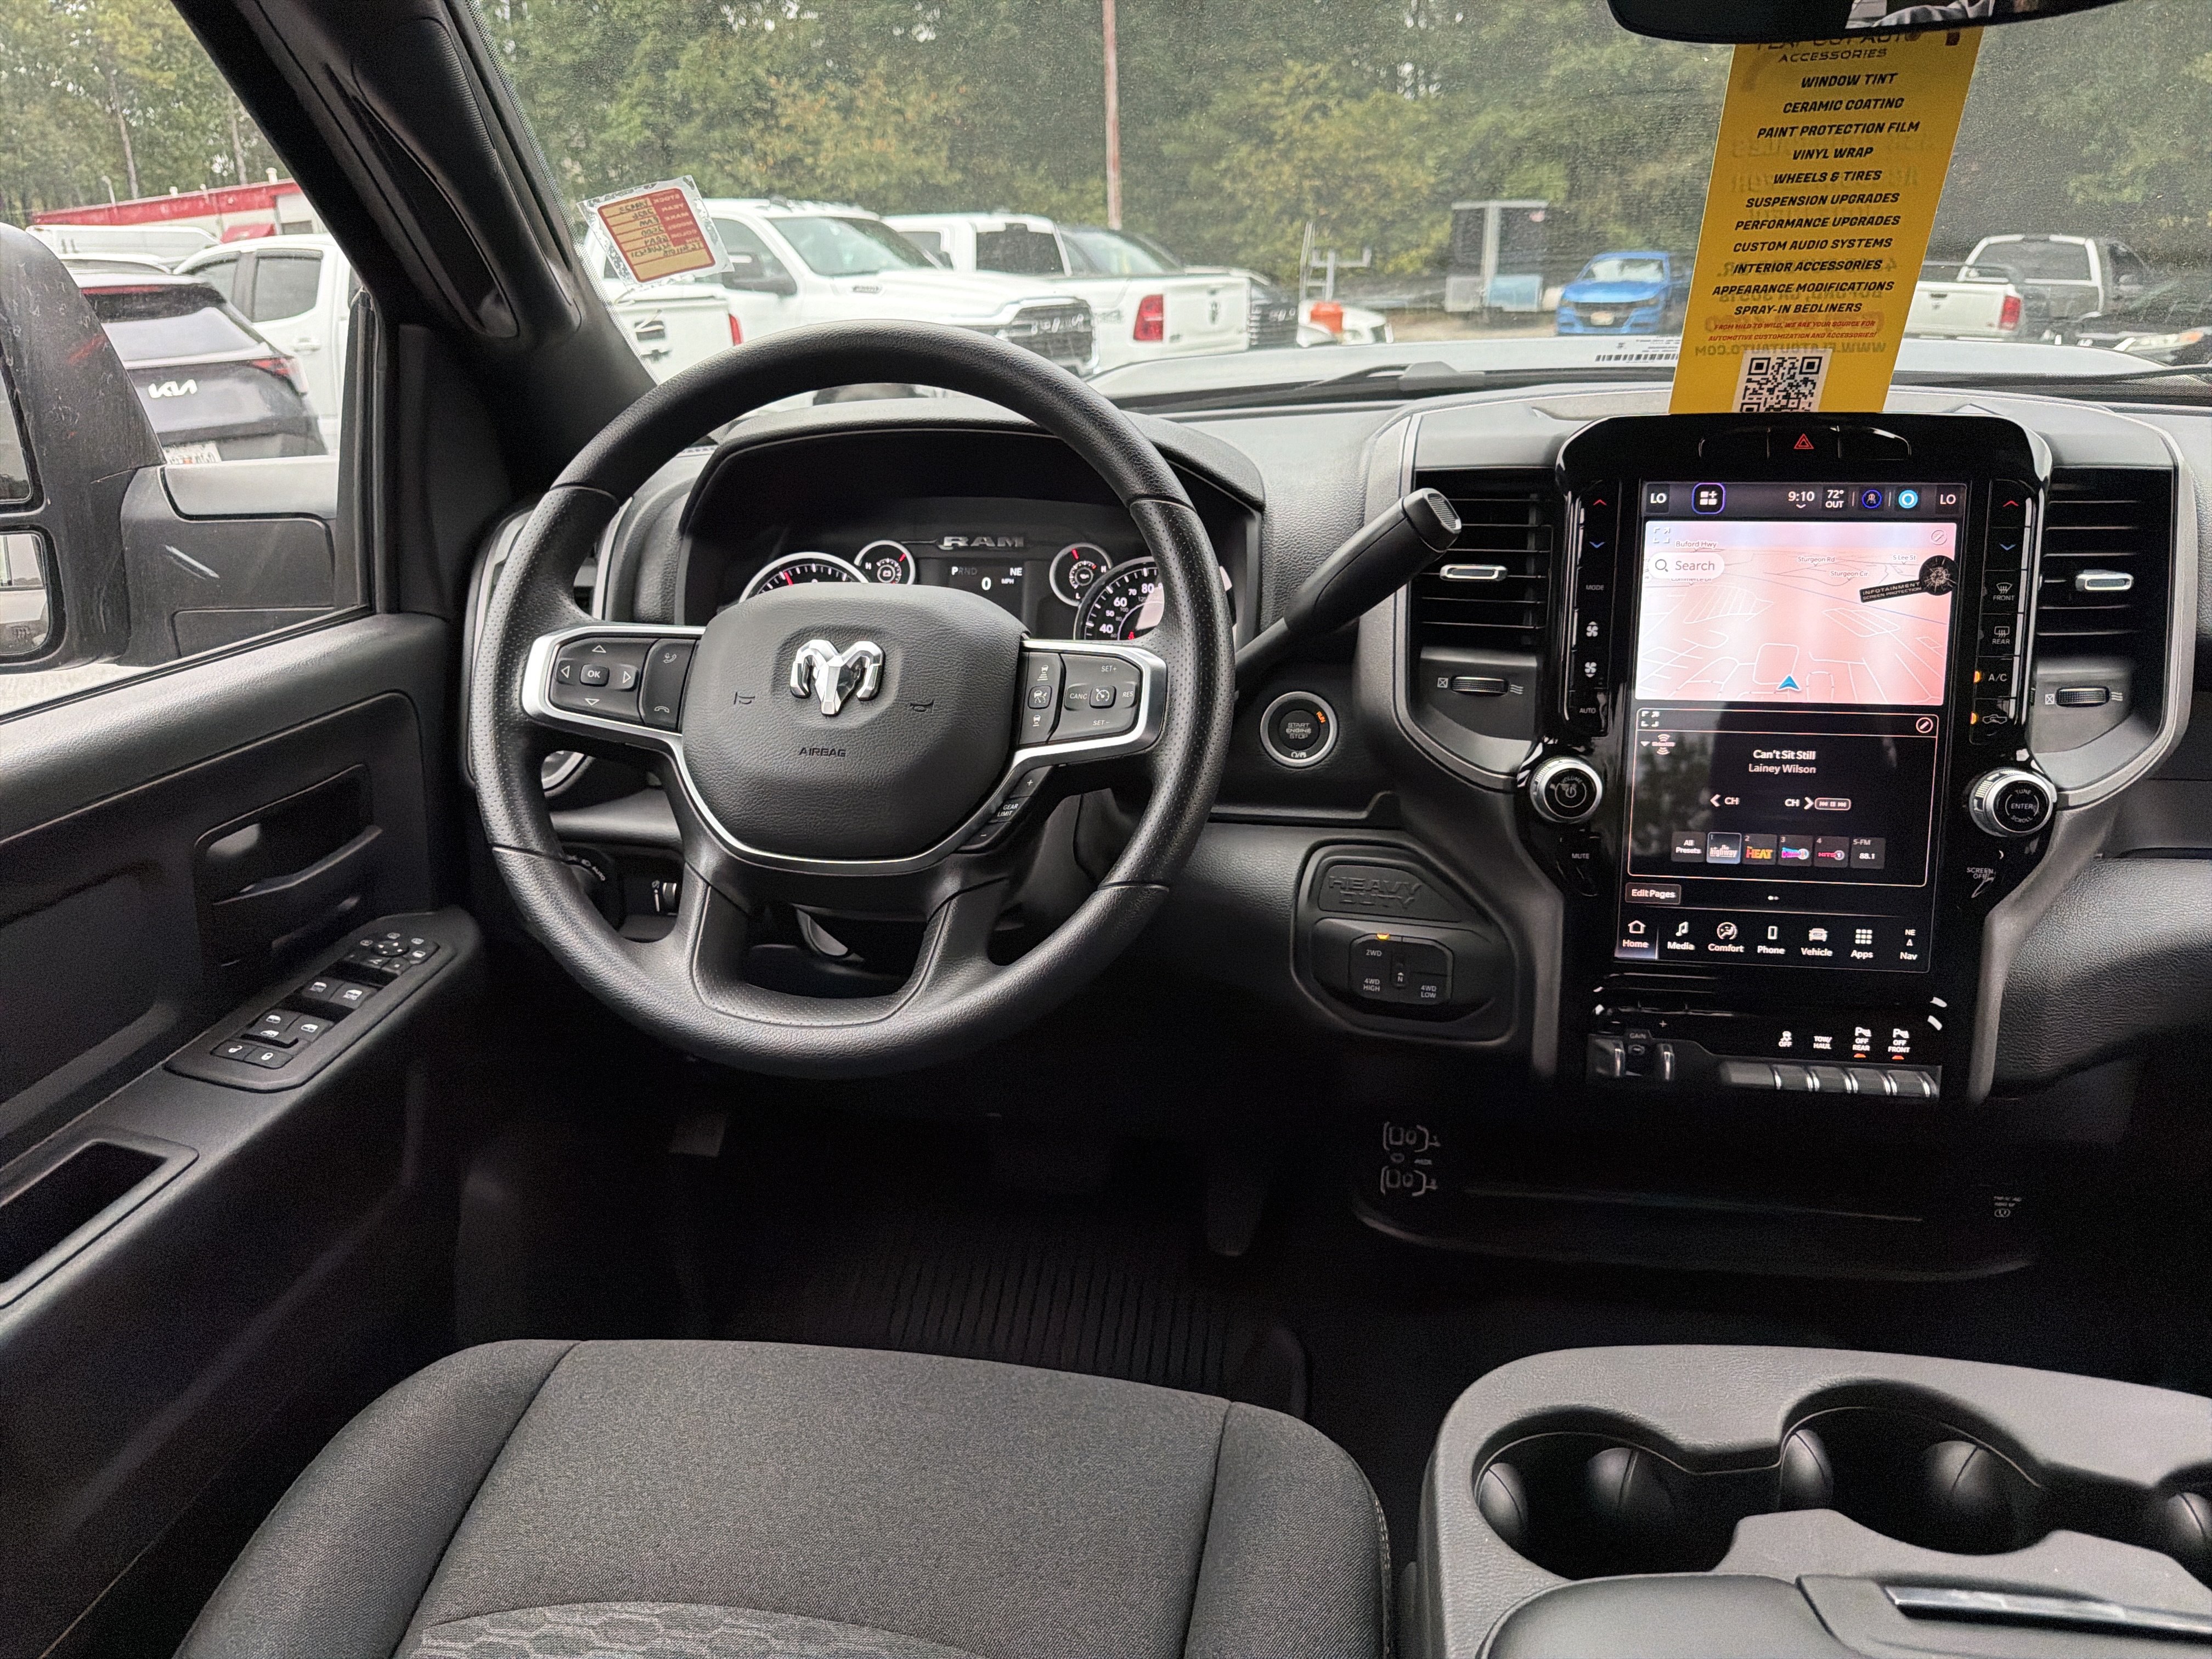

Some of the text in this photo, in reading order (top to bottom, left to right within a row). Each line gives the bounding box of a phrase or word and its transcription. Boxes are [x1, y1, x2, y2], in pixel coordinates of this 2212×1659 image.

[1779, 48, 1887, 62] ACCESSORIES
[1801, 72, 1899, 88] WINDOW TINT
[1782, 97, 1905, 114] CERAMIC COATING
[1757, 121, 1921, 139] PAINT PROTECTION FILM
[1792, 146, 1874, 160] VINYL WRAP
[1773, 170, 1883, 185] WHEELS & TIRES
[1745, 192, 1900, 208] SUSPENSION UPGRADES
[1735, 215, 1901, 231] PERFORMANCE UPGRADES
[1733, 237, 1894, 252] CUSTOM AUDIO SYSTEMS
[1733, 259, 1883, 274] INTERIOR ACCESSORIES
[1712, 281, 1895, 296] APPEARANCE MODIFICATIONS
[1734, 302, 1863, 315] SPRAY-IN BEDLINERS
[1650, 493, 1667, 504] LO
[1787, 489, 1844, 502] 9:10 72°
[1939, 494, 1956, 505] LO
[1825, 500, 1844, 509] OUT
[943, 536, 1024, 547] RAM
[1675, 540, 1717, 549] Buford Hwy
[1675, 560, 1715, 571] Search
[1797, 556, 1825, 565] Sturgeon
[1009, 567, 1023, 577] NE
[1830, 570, 1858, 578] Sturgeon
[981, 577, 991, 590] 0
[1141, 583, 1155, 594] 80
[1863, 582, 1920, 596] INFOTAINMENT
[1886, 586, 1922, 596] PROTECTION
[1114, 597, 1127, 607] 60
[1099, 624, 1114, 634] 40
[587, 669, 601, 679] OK
[1101, 664, 1118, 673] SET+
[1988, 673, 2008, 682] A/C
[1069, 692, 1088, 701] CANC
[1122, 690, 1134, 699] RES
[1316, 711, 1326, 723] RUN
[799, 747, 847, 758] AIRBAG
[1753, 749, 1816, 760] Can't Sit Still
[1748, 764, 1817, 775] Lainey Wilson
[1724, 797, 1740, 805] CH
[1785, 799, 1800, 807] CH
[1709, 847, 1738, 858] highway
[1746, 849, 1773, 859] HEAT
[1329, 876, 1423, 896] HEAVY
[1632, 889, 1676, 899] Edit Pages
[1622, 940, 1649, 949] Home
[1667, 941, 1785, 955] Media Comfort Phone
[1801, 947, 1833, 957] Vehicle
[1850, 950, 1874, 960] Apps
